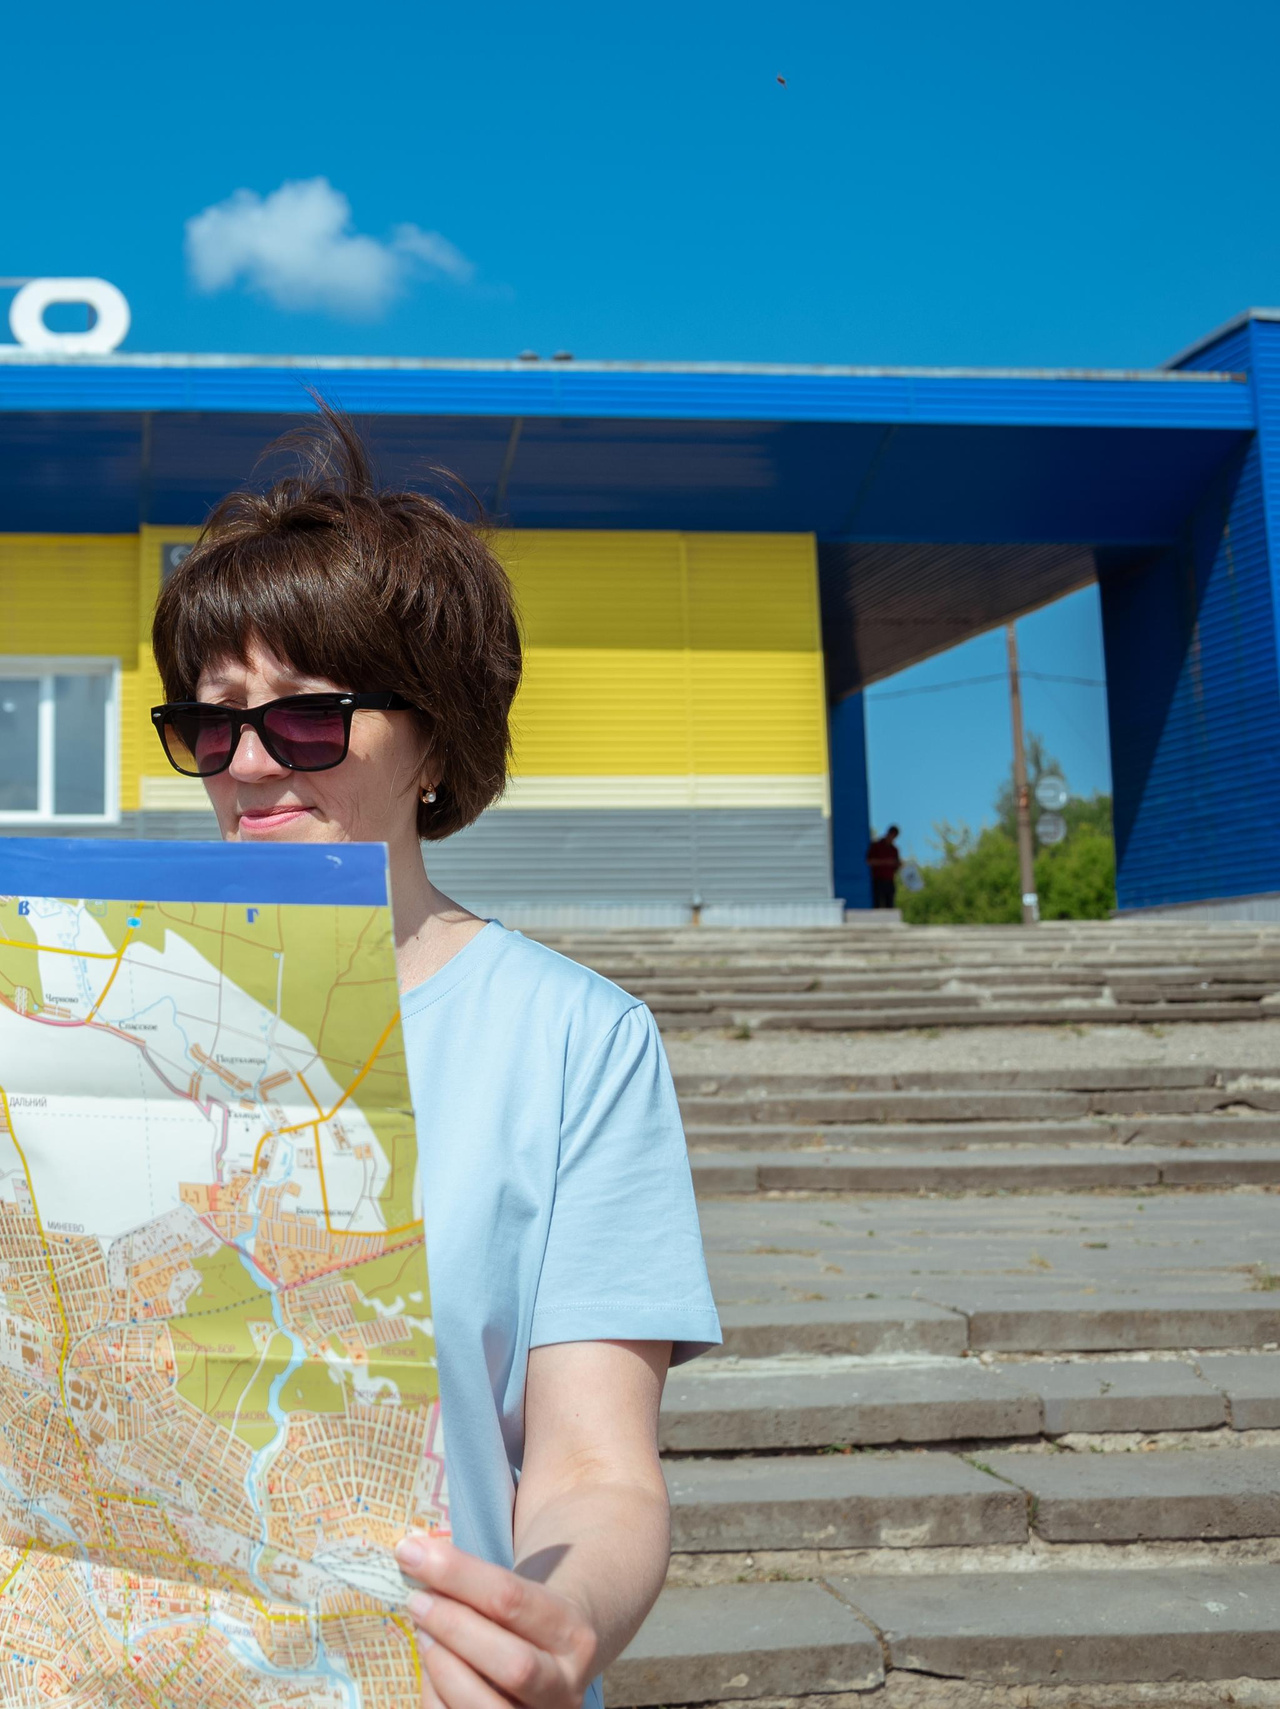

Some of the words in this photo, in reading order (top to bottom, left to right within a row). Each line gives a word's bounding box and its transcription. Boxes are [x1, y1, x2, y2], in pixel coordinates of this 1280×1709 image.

[18, 900, 30, 915] В
[245, 908, 260, 923] Г
[8, 1096, 47, 1107] ДАЛЬНИЙ
